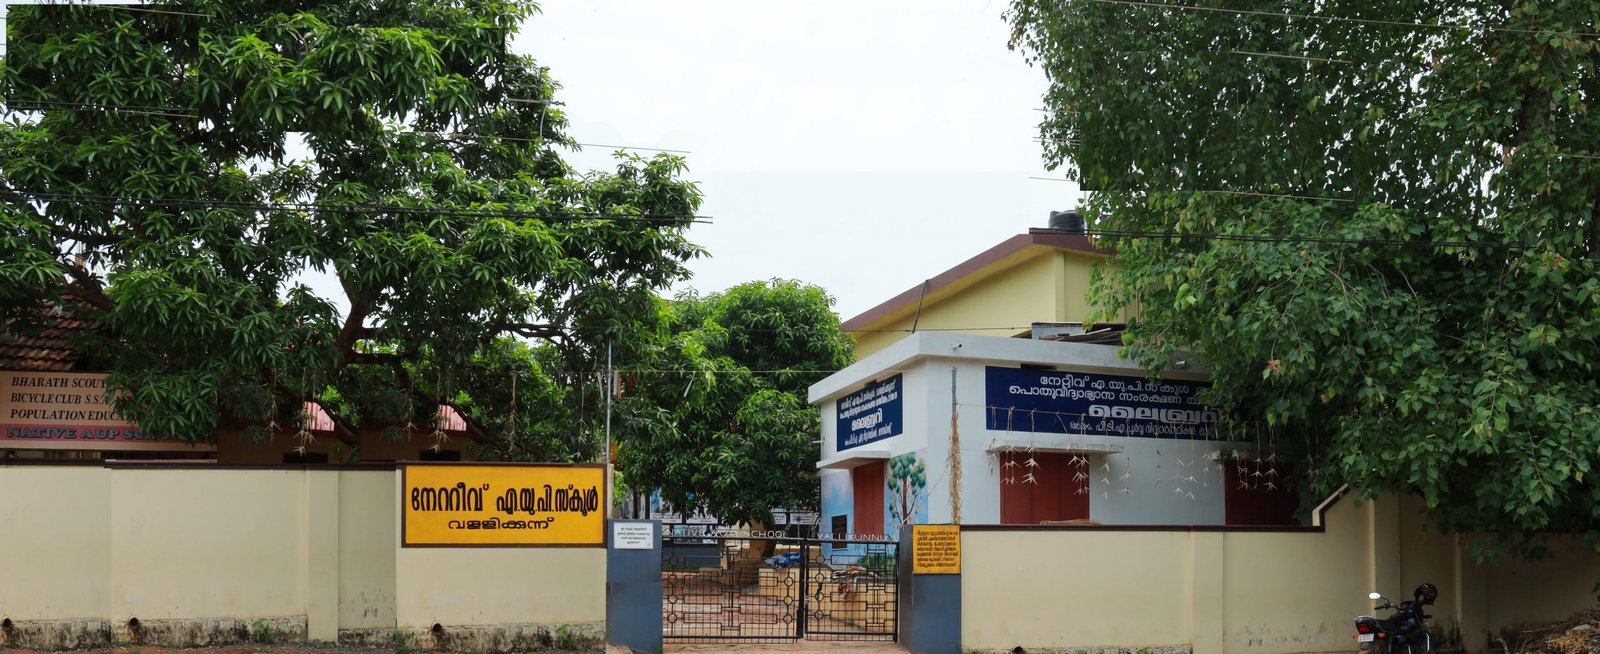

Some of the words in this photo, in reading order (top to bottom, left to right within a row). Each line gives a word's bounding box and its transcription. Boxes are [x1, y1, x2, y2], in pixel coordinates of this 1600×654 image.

[11, 376, 68, 388] BHARATH
[11, 392, 54, 403] BICYCLE
[55, 393, 81, 404] CLUB
[1008, 385, 1115, 401] പൊതുവിദ്യാഭ്യാസ
[1118, 391, 1182, 405] സംരക്ഷണ
[10, 408, 86, 421] POPULATION
[852, 408, 882, 431] ലൈബ്രറി
[1088, 404, 1223, 425] ലൈബ്രറി
[6, 427, 77, 440] NATIVE
[80, 428, 120, 440] AUP
